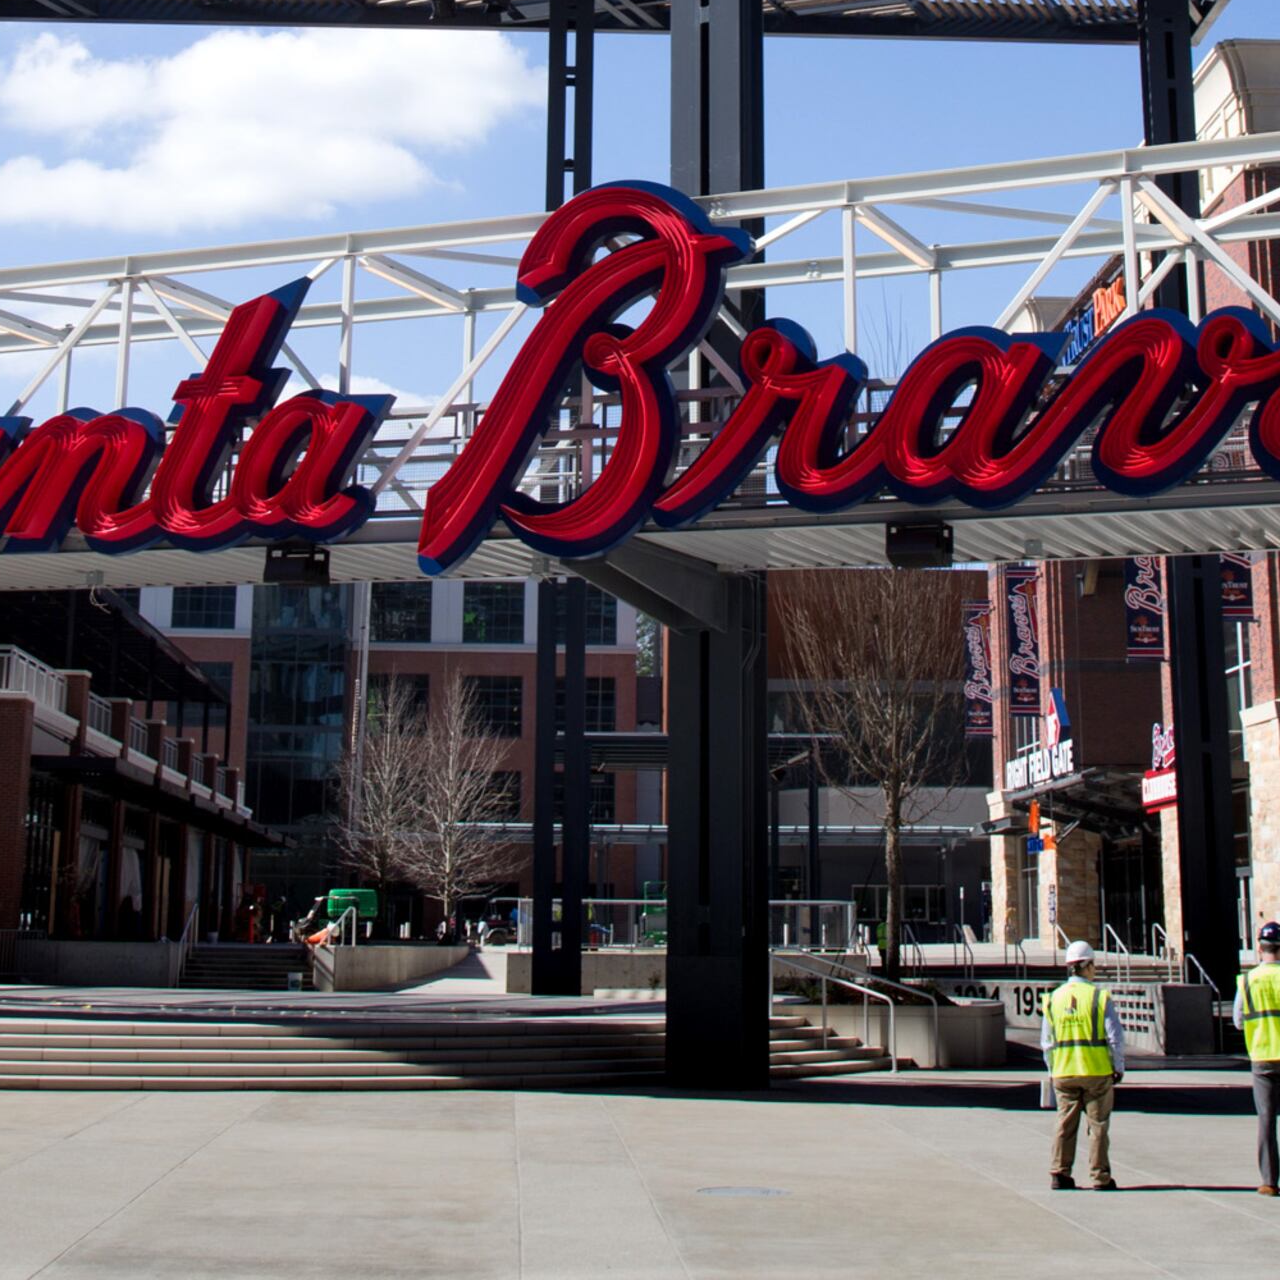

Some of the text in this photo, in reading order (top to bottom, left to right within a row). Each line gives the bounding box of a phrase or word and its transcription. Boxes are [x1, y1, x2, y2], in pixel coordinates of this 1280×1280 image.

[1093, 276, 1127, 337] PARK
[963, 626, 992, 703] Braves
[1008, 594, 1040, 680] Braves
[1028, 749, 1051, 784] FIELD
[1052, 739, 1074, 777] GATE
